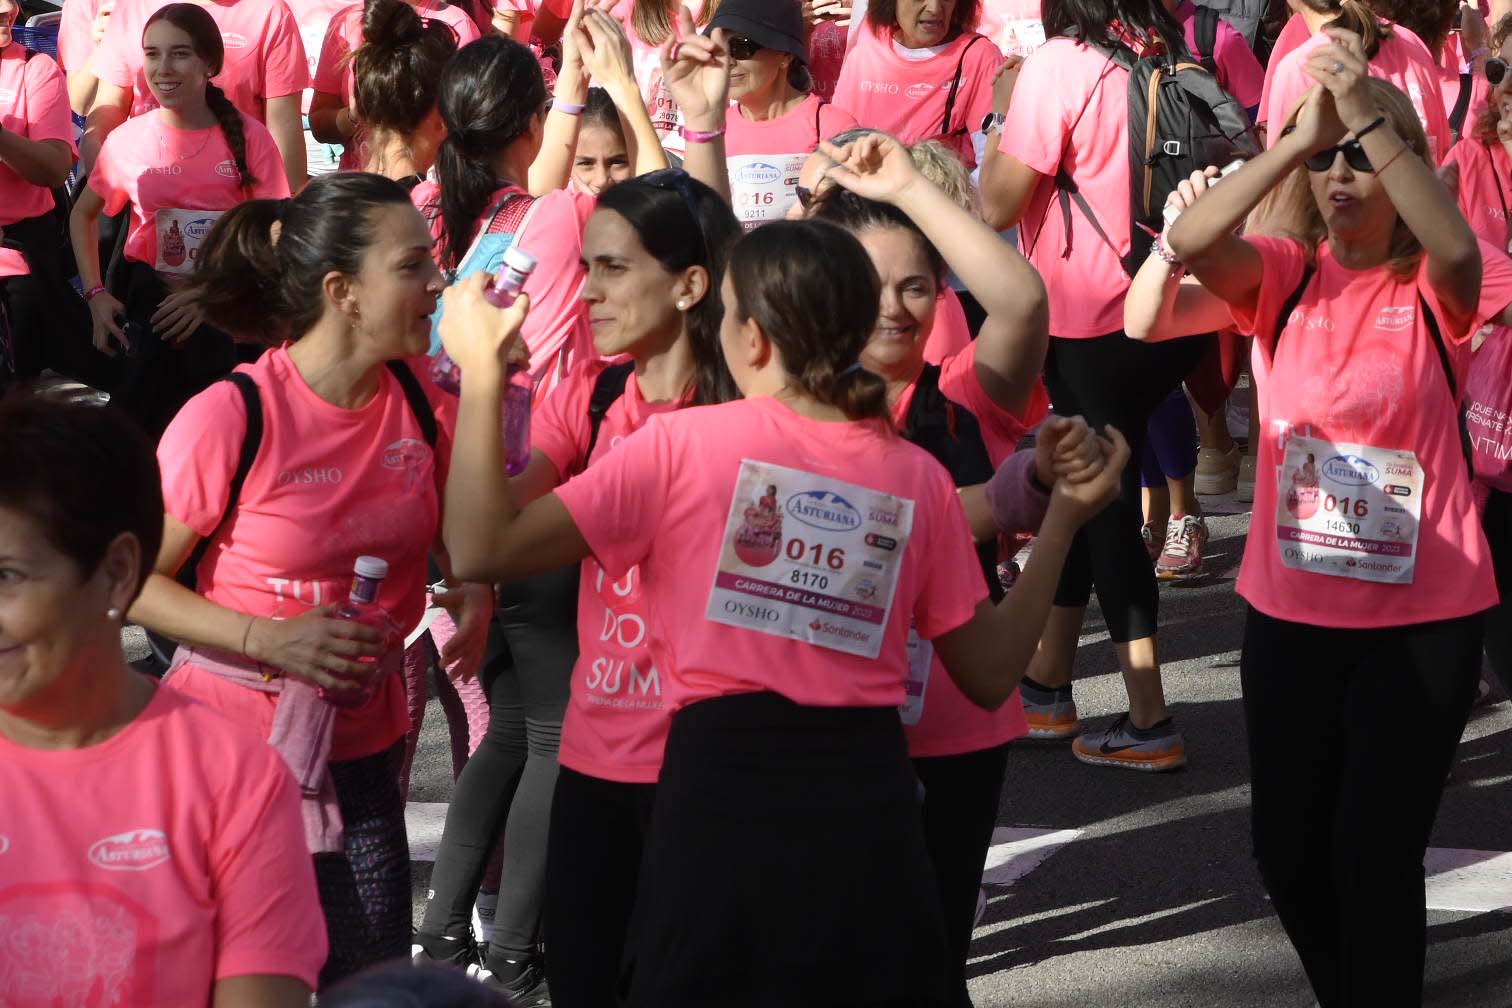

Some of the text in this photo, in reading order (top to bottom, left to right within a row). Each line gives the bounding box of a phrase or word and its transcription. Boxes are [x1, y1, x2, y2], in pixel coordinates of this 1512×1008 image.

[1327, 464, 1376, 482] ASTURIANA
[1385, 467, 1413, 477] SUMA
[791, 498, 856, 527] ASTURIANA
[1324, 494, 1369, 517] 016
[1326, 519, 1361, 535] 14630
[1290, 530, 1325, 544] CARRERA
[1326, 537, 1337, 546] DE
[1338, 538, 1349, 548] LA
[1350, 540, 1379, 552] MUJER
[785, 538, 846, 571] 016
[1358, 558, 1403, 573] Santander
[790, 569, 829, 590] 8170
[735, 578, 785, 598] CARRERA
[787, 589, 801, 601] DE
[803, 592, 816, 604] LA
[818, 596, 850, 612] MUJER
[724, 600, 780, 622] OYSHO
[822, 621, 871, 642] Santander
